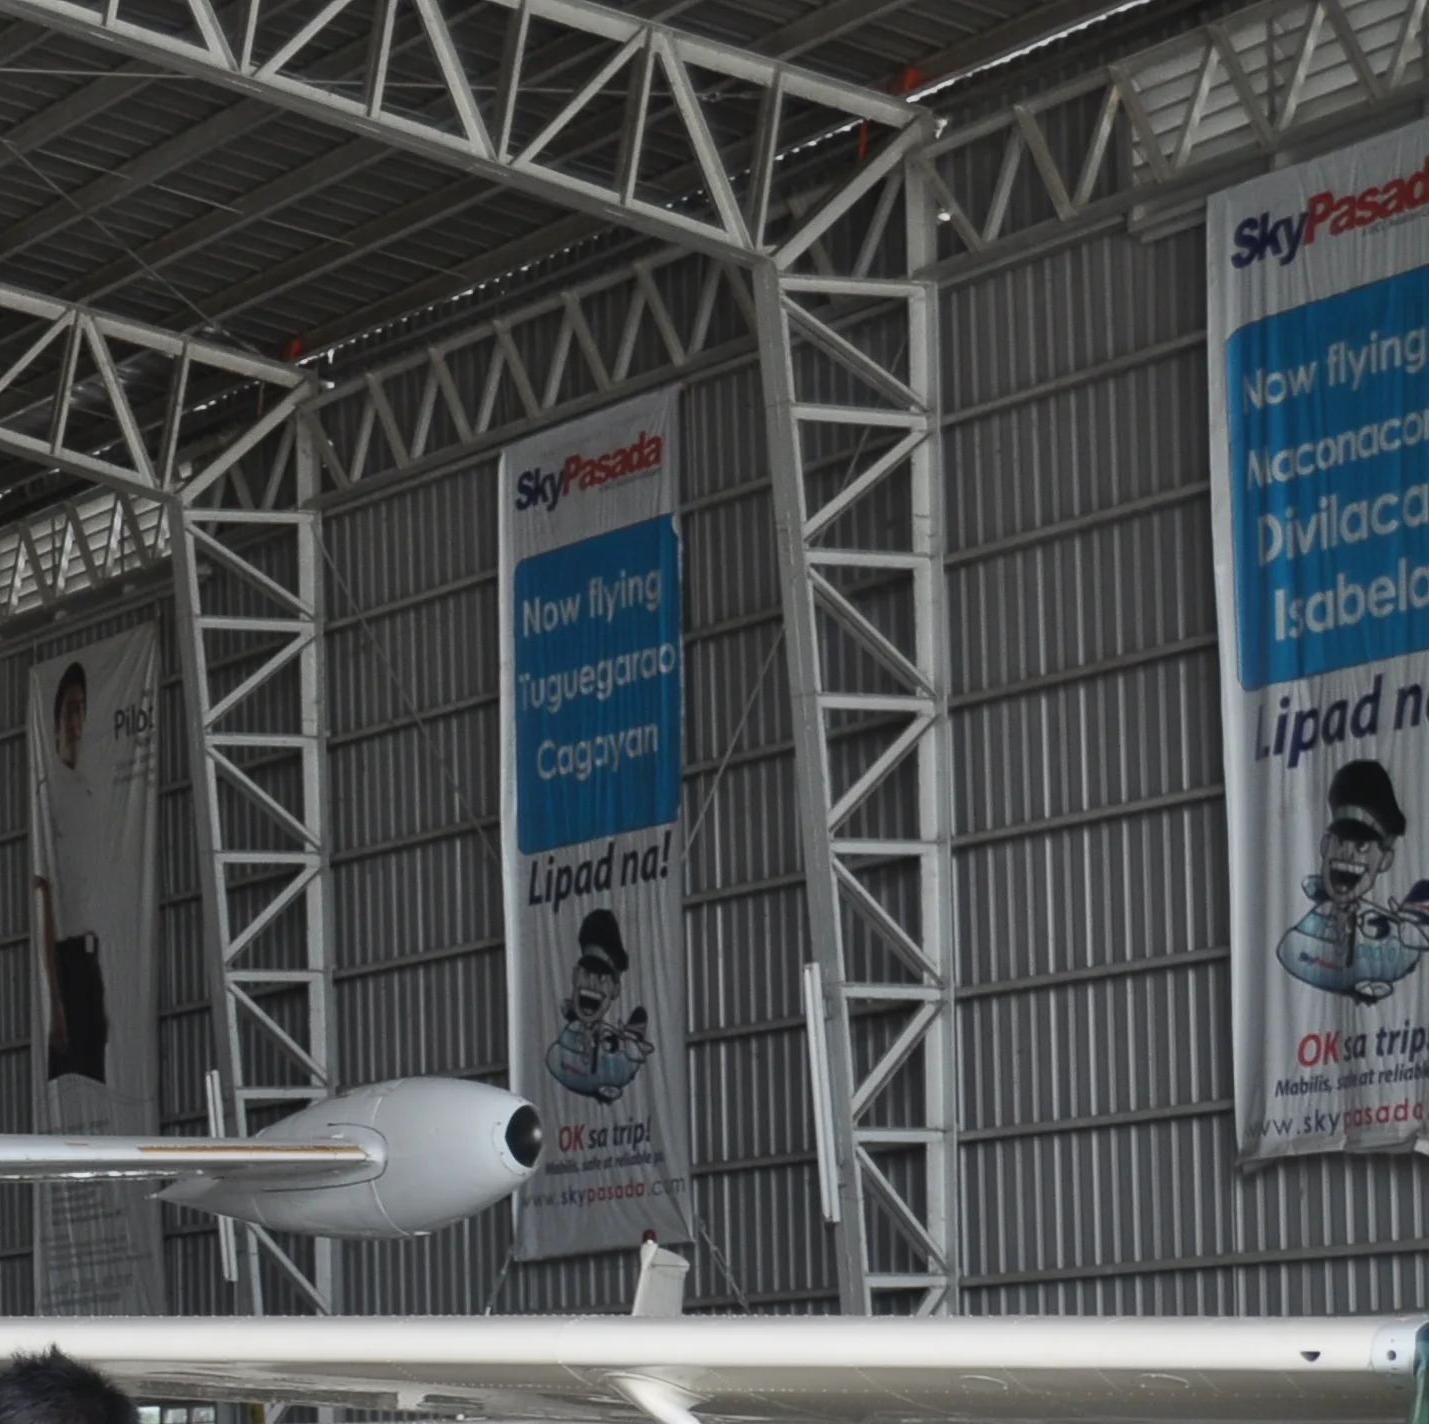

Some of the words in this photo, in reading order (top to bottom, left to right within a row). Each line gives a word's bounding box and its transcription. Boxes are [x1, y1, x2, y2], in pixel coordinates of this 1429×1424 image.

[1244, 361, 1318, 415] Now
[1328, 327, 1427, 392] flying
[515, 431, 663, 511] SkyPasada
[1248, 408, 1429, 492] Maconaco
[523, 593, 581, 638] Now
[589, 569, 662, 623] flying
[518, 642, 676, 715] Tuguegarao
[537, 723, 659, 782] Cagayan
[1255, 673, 1383, 769] Lipad
[1393, 683, 1429, 731] n
[528, 841, 615, 914] Lipad
[620, 830, 672, 887] na!
[1297, 1031, 1340, 1068] OK
[1343, 1033, 1367, 1062] sa
[1376, 1018, 1429, 1062] trip
[1275, 1074, 1333, 1098] Mabilis,
[558, 1124, 585, 1153] OK
[588, 1127, 608, 1150] sa
[612, 1115, 651, 1152] trip!
